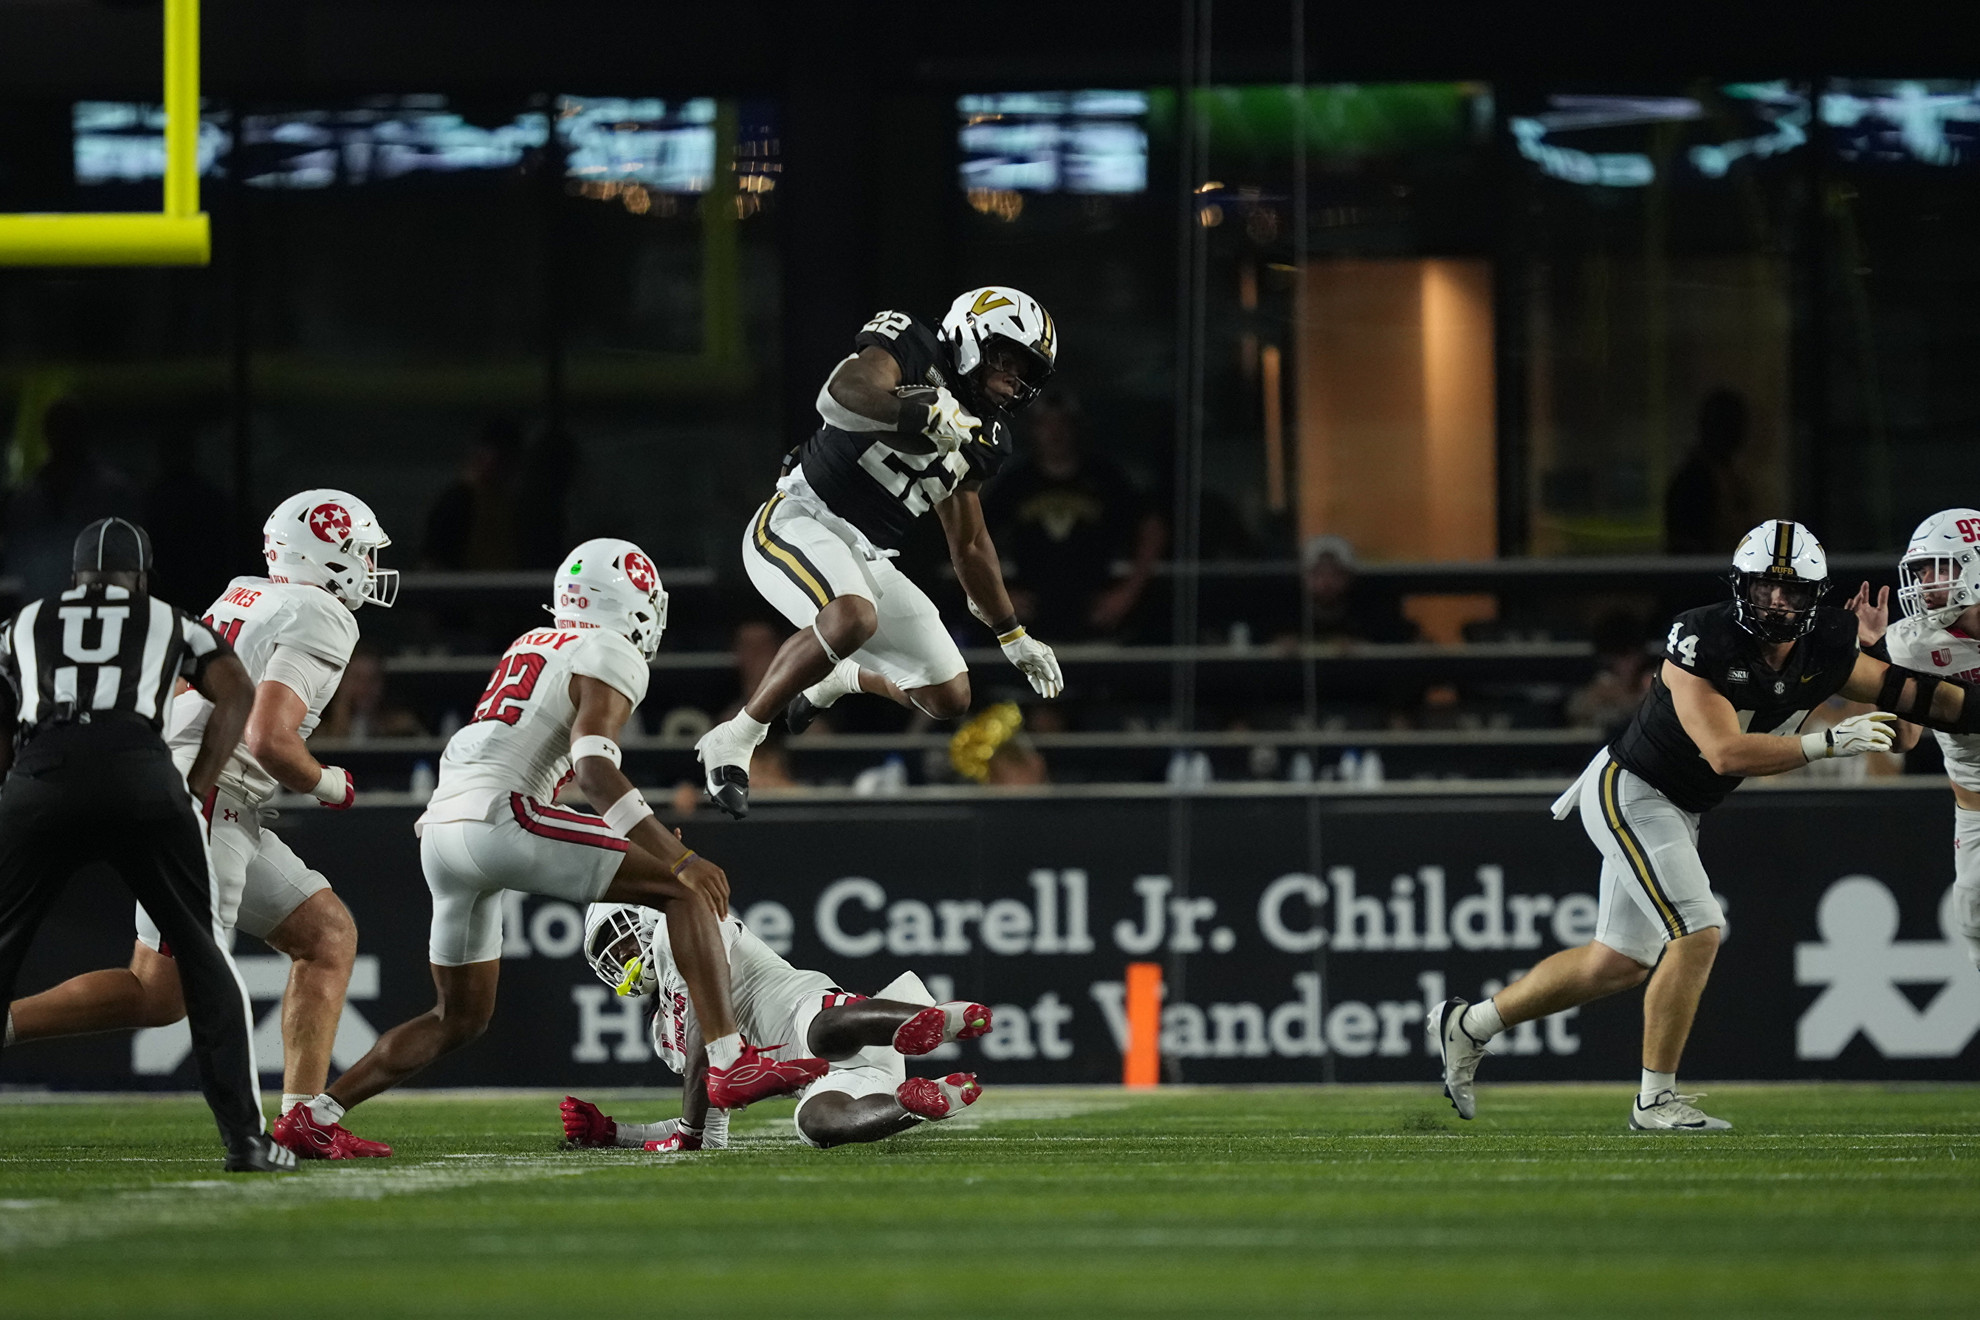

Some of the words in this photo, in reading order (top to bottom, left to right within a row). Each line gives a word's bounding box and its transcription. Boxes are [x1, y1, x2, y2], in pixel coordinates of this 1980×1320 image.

[970, 289, 1016, 317] V
[860, 309, 913, 341] 22
[992, 421, 1002, 446] C
[1771, 565, 1795, 576] VUFB
[219, 586, 263, 608] ONES
[58, 606, 130, 663] U
[1665, 621, 1700, 668] 44
[467, 652, 548, 728] 22
[814, 867, 1096, 957] Carell
[1112, 874, 1237, 954] Jr.
[1256, 864, 1728, 954] Childre
[978, 991, 1073, 1061] at
